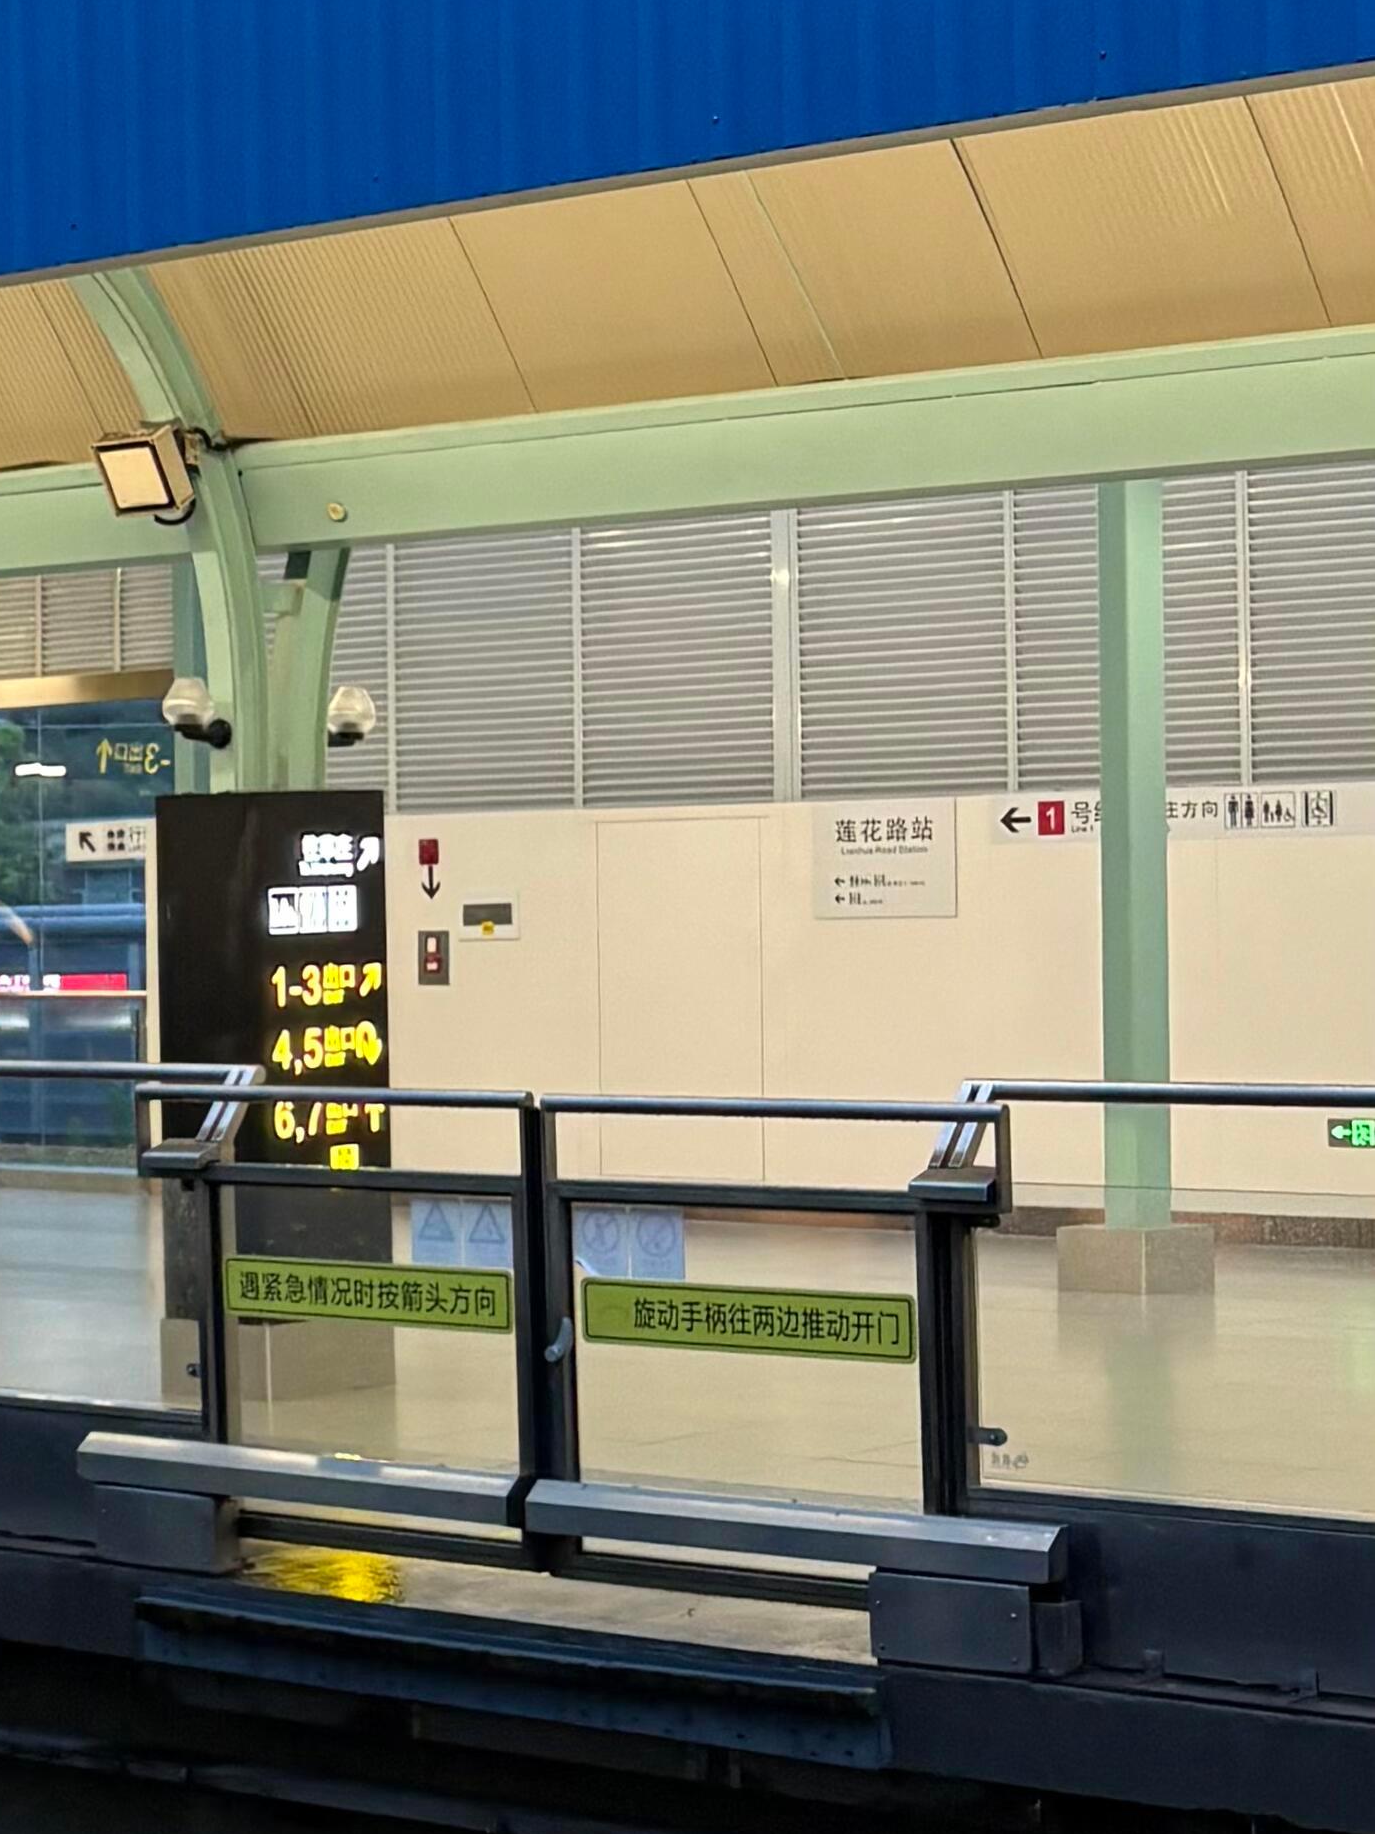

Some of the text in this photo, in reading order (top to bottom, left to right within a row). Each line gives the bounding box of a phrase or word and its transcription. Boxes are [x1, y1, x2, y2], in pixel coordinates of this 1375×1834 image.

[835, 815, 933, 843] 莲花路站
[239, 1271, 496, 1317] 遇紧急情况时按箭头方向
[634, 1297, 900, 1345] 旋动手柄往两边推动开门
